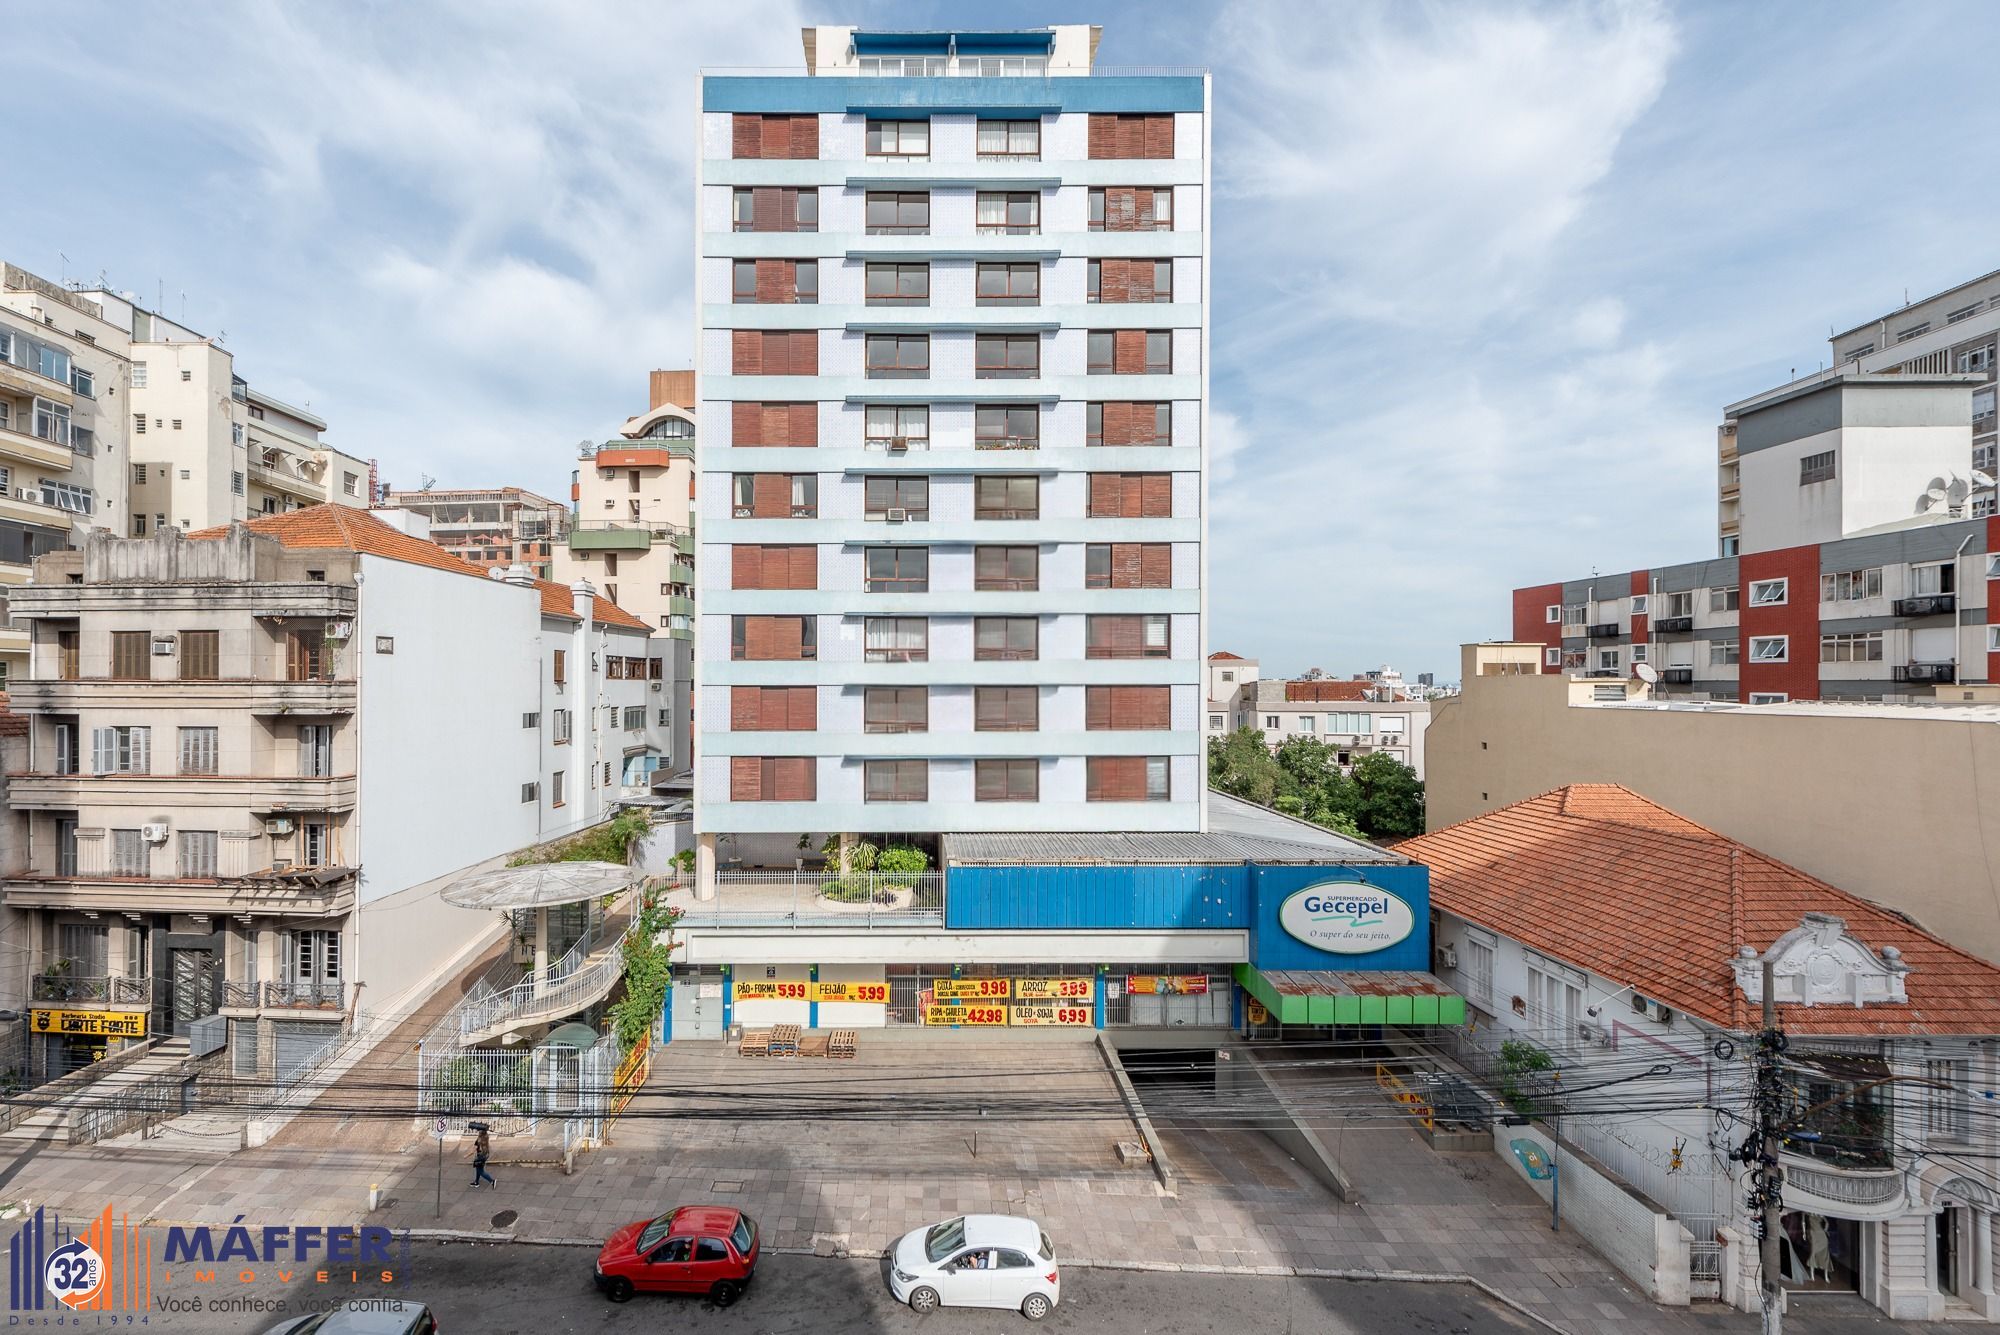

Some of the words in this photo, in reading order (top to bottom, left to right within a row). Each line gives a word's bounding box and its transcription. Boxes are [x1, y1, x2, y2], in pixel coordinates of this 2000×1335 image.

[1304, 896, 1388, 919] Gecepel
[1309, 930, 1317, 938] O
[1319, 931, 1341, 941] super
[1343, 930, 1354, 939] do
[1370, 931, 1391, 942] jeito.
[754, 983, 776, 993] FORMA
[777, 984, 806, 999] 5.99
[819, 983, 847, 995] FEIJÃO
[858, 986, 885, 1001] 5.99
[980, 980, 1007, 996] 9.98
[1021, 981, 1048, 992] ARROZ
[967, 1008, 1003, 1024] 42.98
[1036, 1007, 1054, 1019] SOJA
[1058, 1008, 1087, 1024] 6.99
[100, 1020, 139, 1034] FORTE
